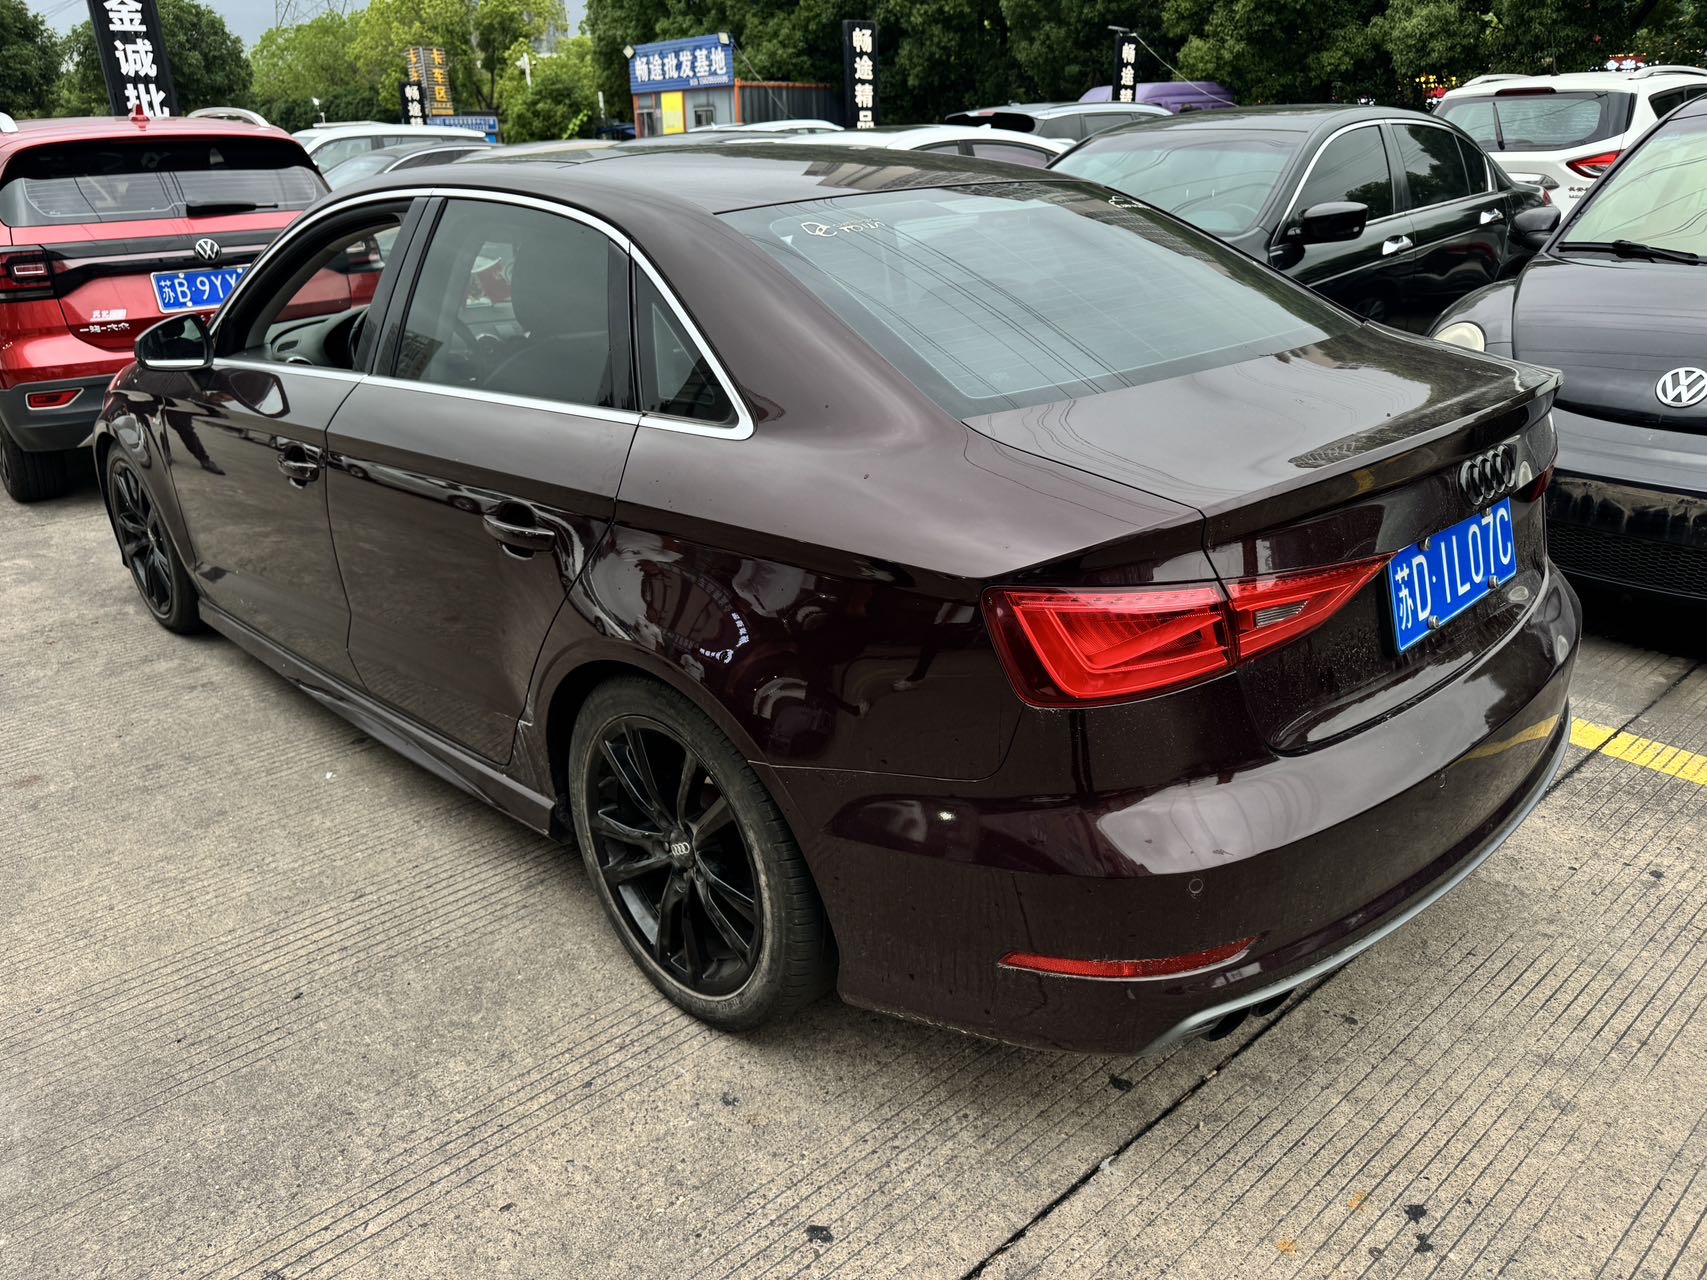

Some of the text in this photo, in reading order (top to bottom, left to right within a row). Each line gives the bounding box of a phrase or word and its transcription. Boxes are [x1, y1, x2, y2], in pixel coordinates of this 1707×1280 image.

[103, 0, 170, 117] 金诚批
[431, 47, 448, 102] 卡车区
[635, 47, 727, 83] 畅途批发基地
